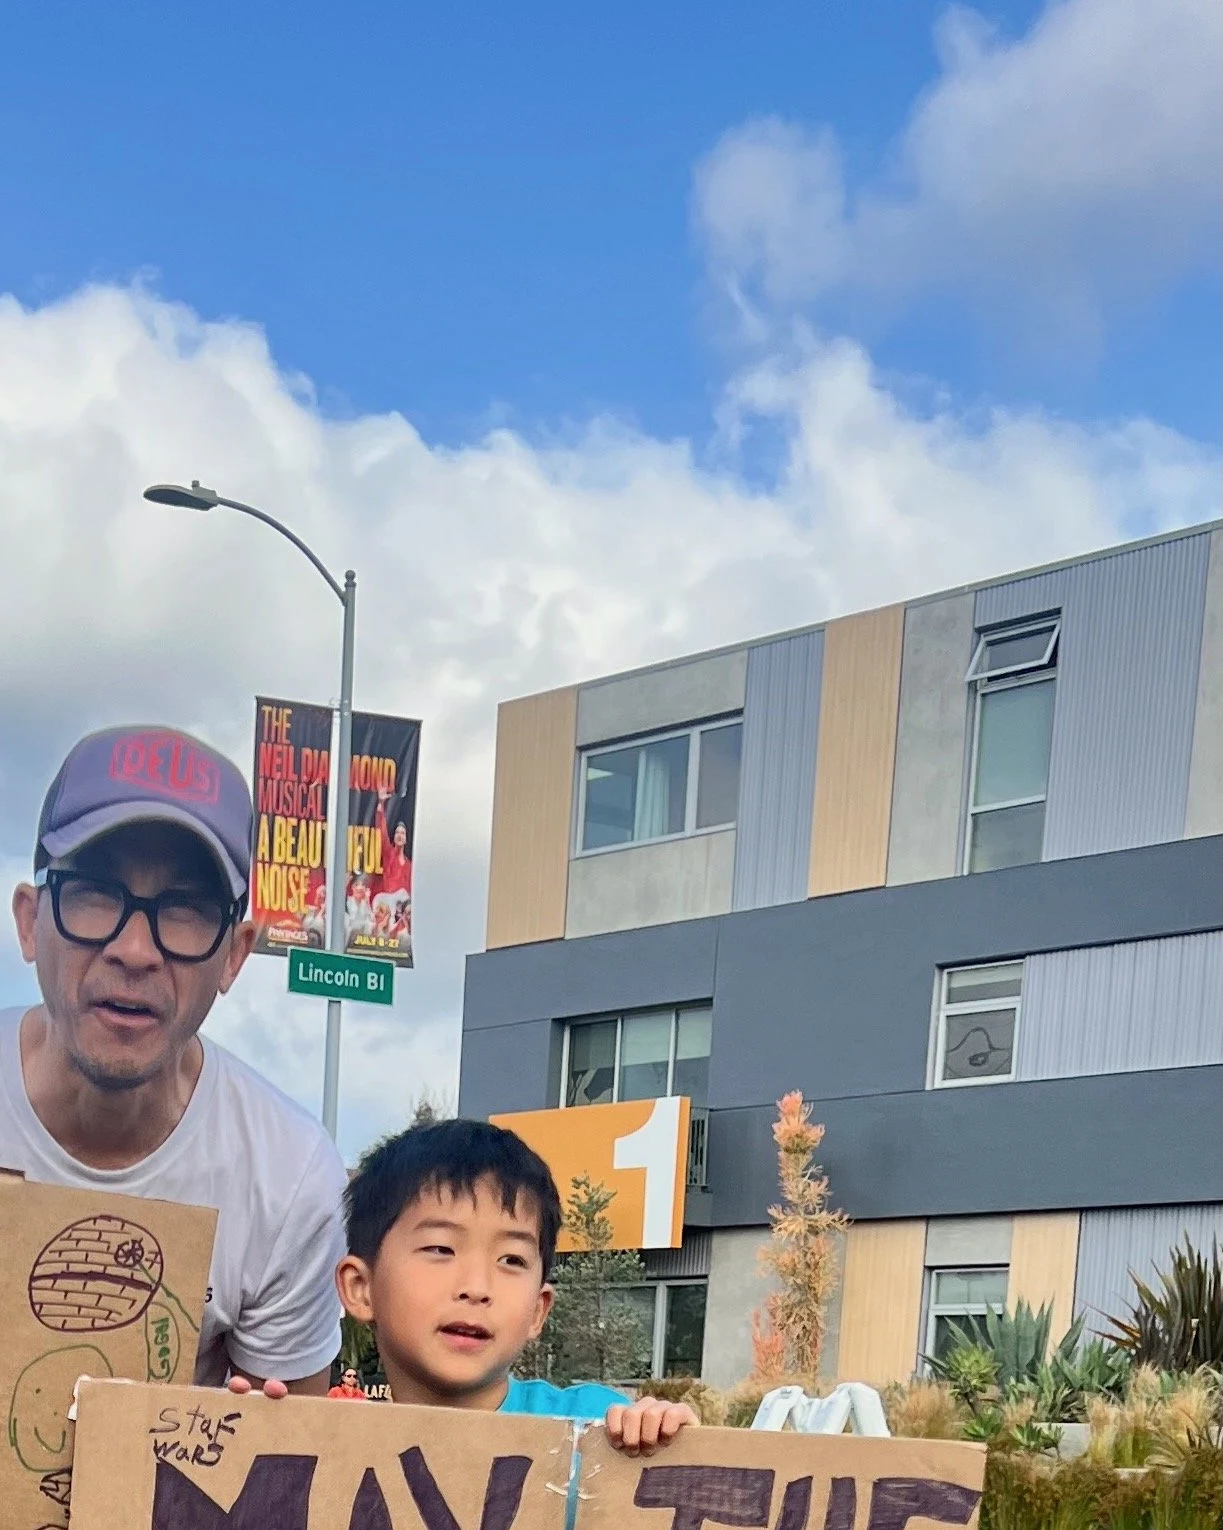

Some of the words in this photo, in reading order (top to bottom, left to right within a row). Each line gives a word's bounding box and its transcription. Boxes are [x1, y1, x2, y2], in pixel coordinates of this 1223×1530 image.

[262, 705, 292, 744] THE
[123, 739, 212, 793] DEUS
[259, 742, 298, 780] NEIL
[259, 778, 325, 820] MUSICAL
[257, 814, 269, 862] A
[256, 862, 310, 914] NOISE
[298, 962, 359, 988] Lincoln
[613, 1096, 681, 1249] 1
